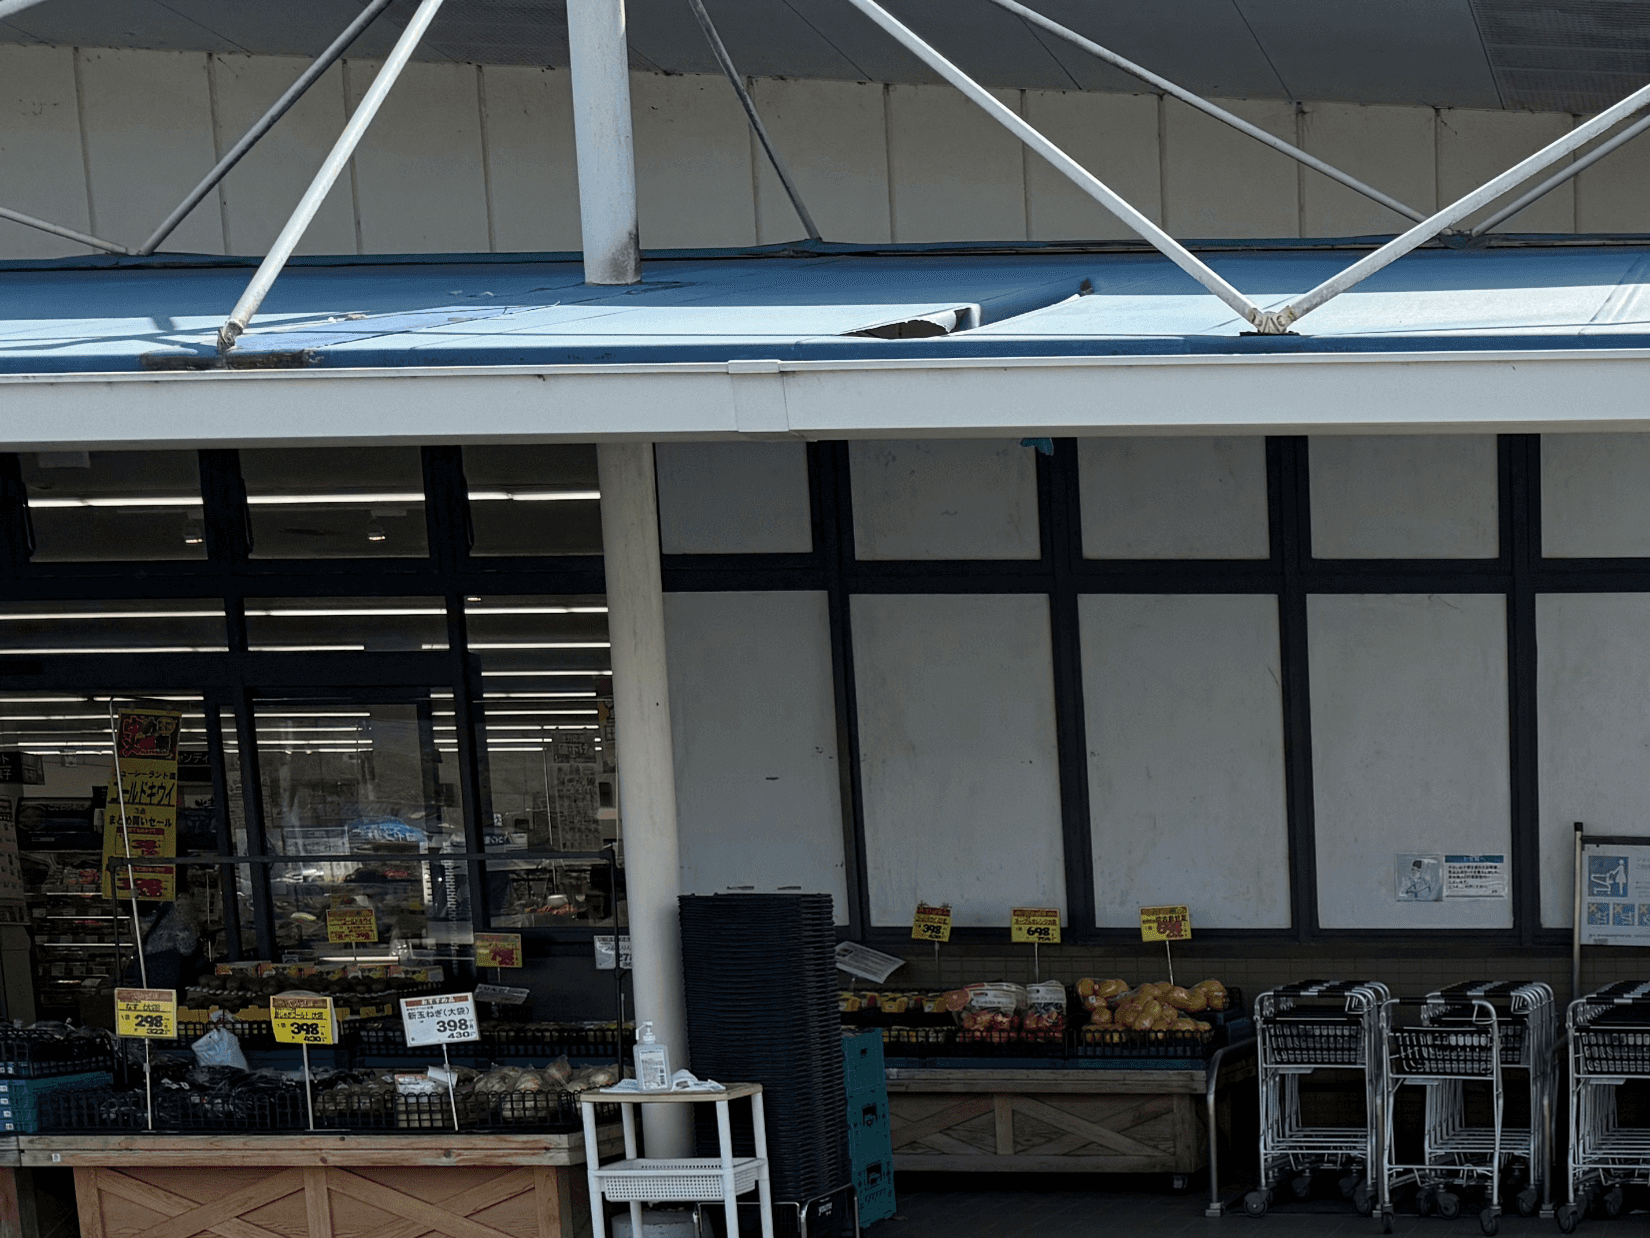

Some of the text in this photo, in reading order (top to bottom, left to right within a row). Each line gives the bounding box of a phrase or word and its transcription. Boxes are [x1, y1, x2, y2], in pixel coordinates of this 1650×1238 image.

[1027, 927, 1050, 936] 698
[135, 1014, 164, 1028] 298
[436, 1018, 469, 1033] 398
[290, 1022, 319, 1035] 398
[447, 1031, 470, 1039] 430
